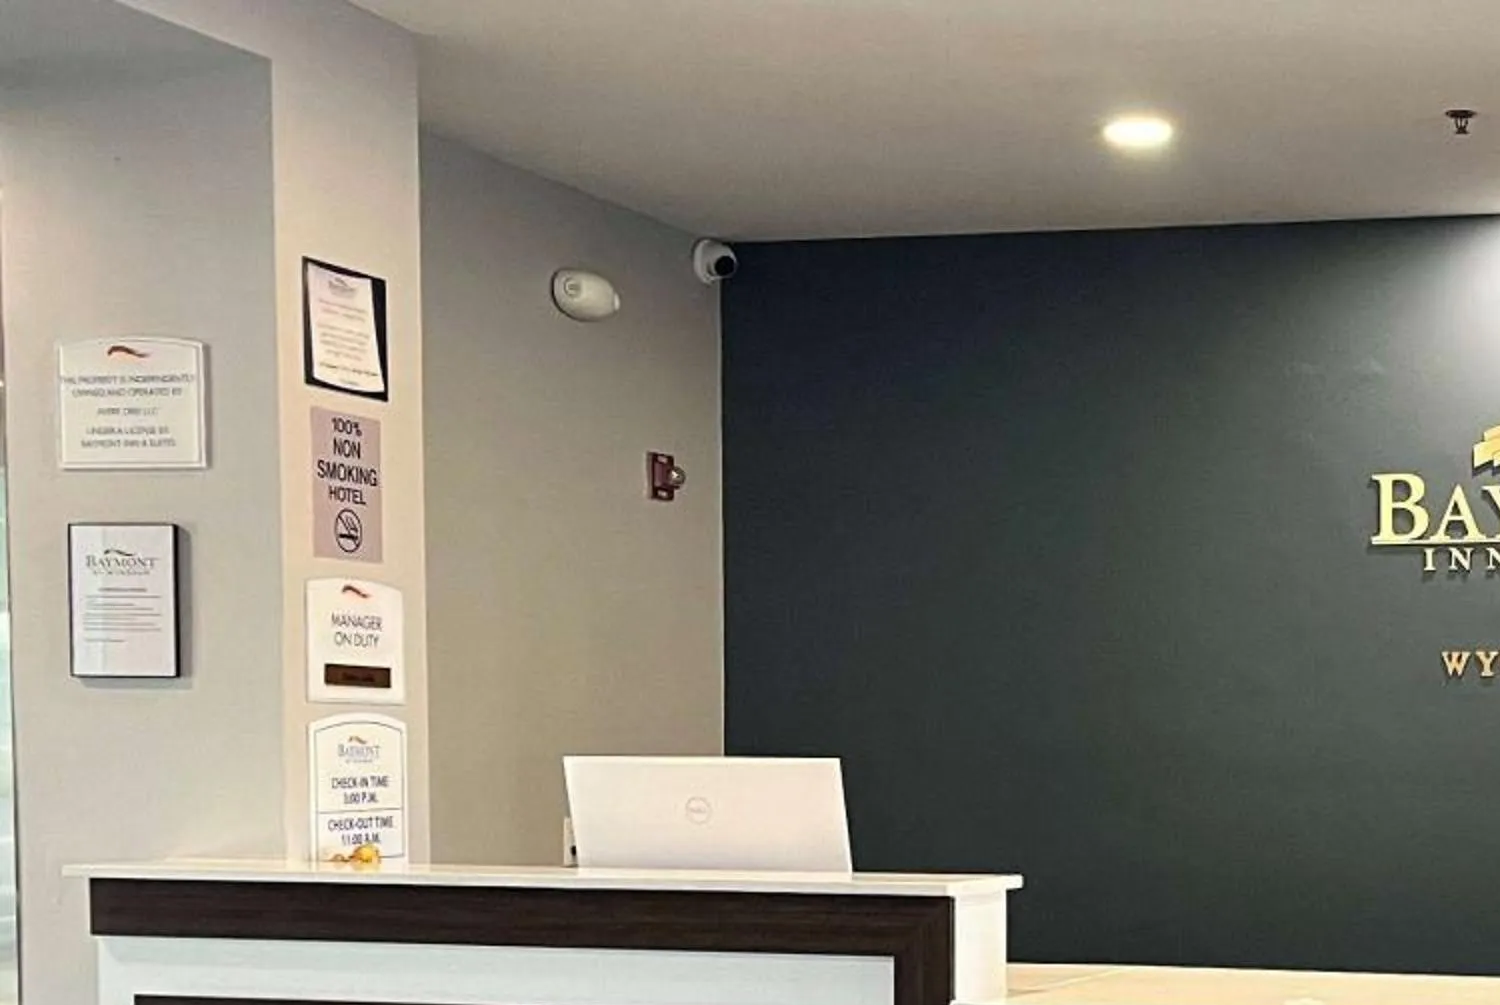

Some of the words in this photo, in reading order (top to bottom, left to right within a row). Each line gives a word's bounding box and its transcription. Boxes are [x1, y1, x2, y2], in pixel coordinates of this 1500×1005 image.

[332, 417, 362, 437] 100%
[333, 437, 361, 459] NON
[317, 459, 378, 487] SMOKING
[328, 486, 367, 505] HOTEL
[86, 555, 159, 568] BAYMONT
[331, 612, 383, 631] MANAGER
[335, 631, 352, 646] ON
[354, 632, 380, 647] DUTY
[370, 775, 390, 788] TIME
[375, 815, 393, 829] TIME
